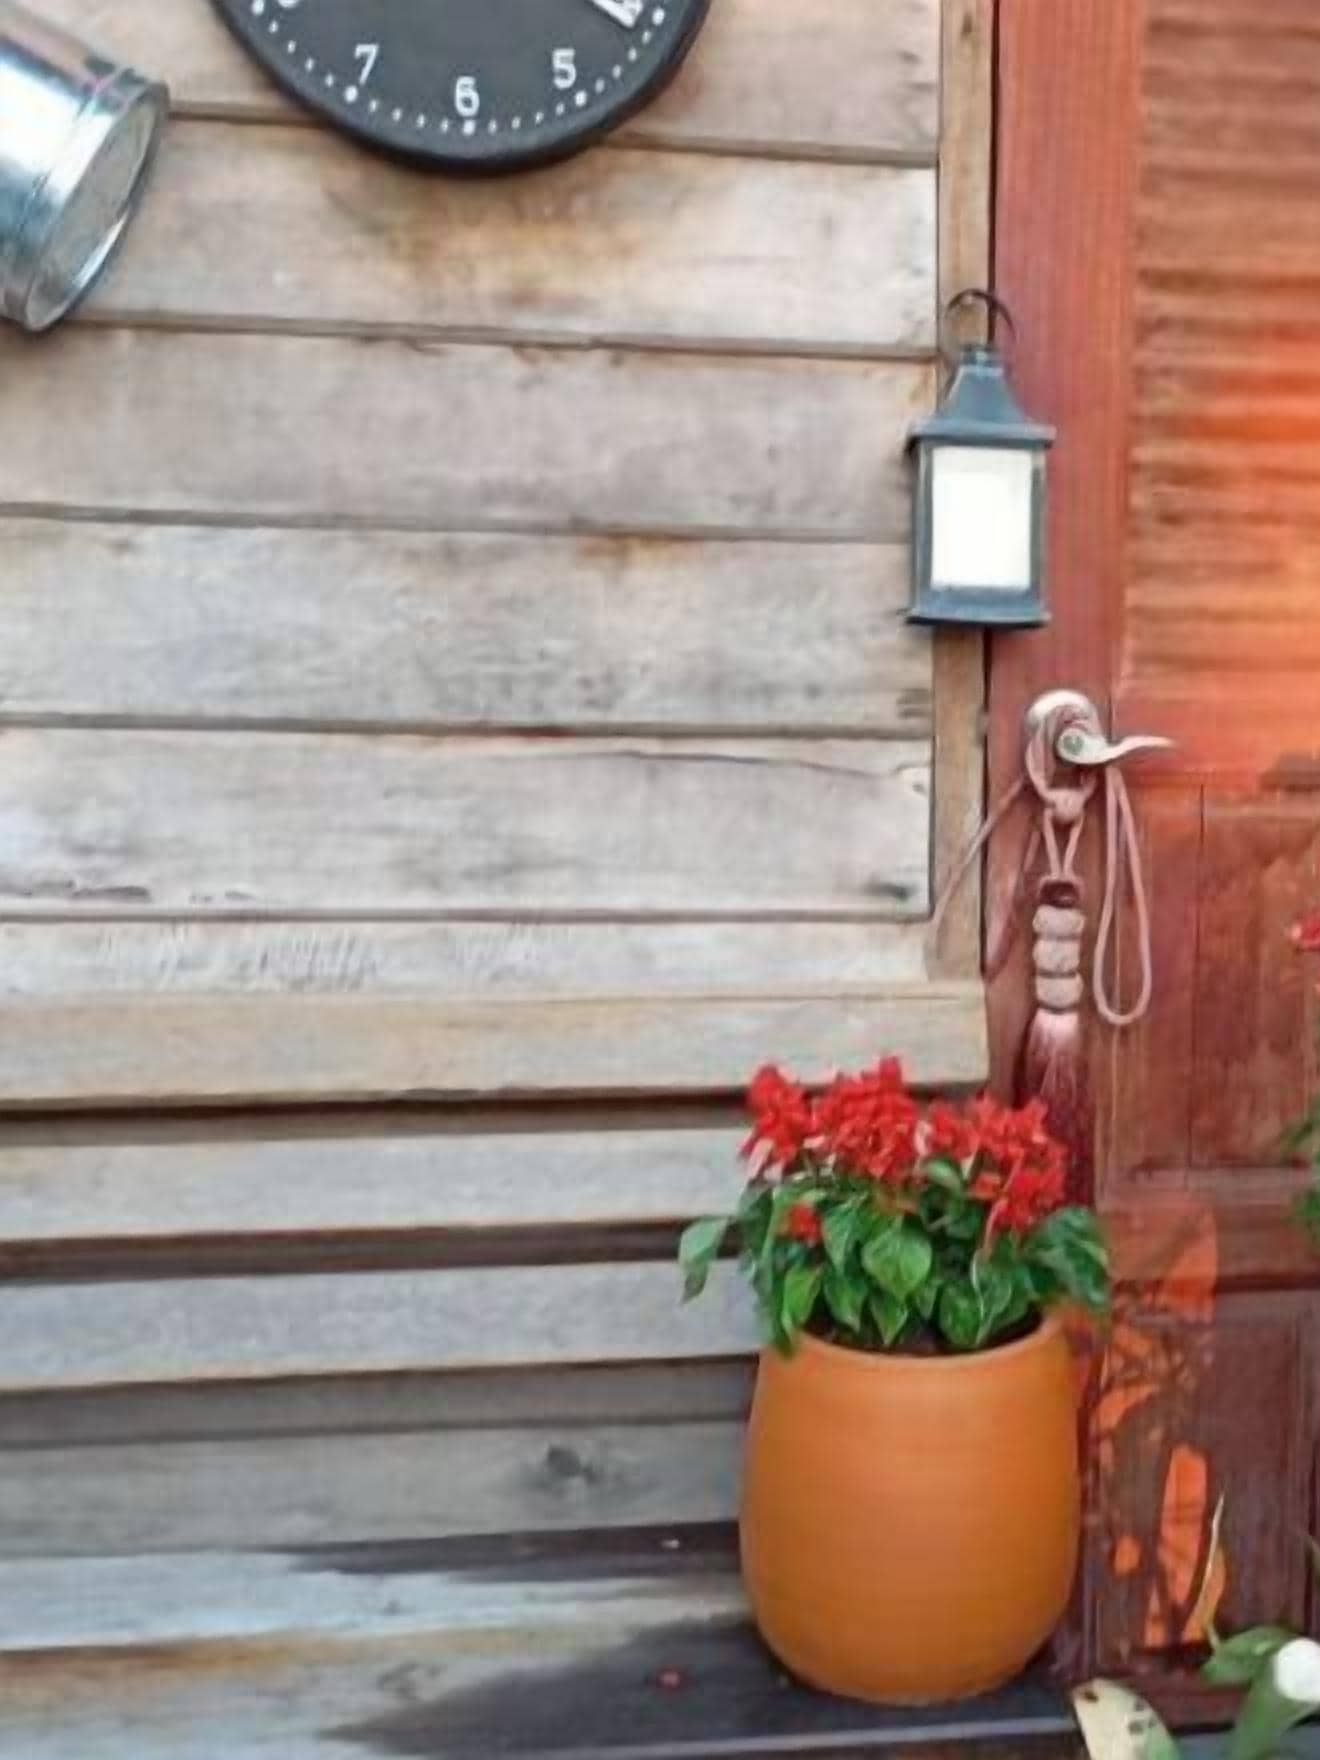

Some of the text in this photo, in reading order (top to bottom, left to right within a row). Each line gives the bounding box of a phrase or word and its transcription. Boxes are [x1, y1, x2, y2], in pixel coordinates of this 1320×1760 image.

[355, 43, 379, 85] 7
[552, 48, 576, 88] 5
[455, 76, 480, 116] 6
